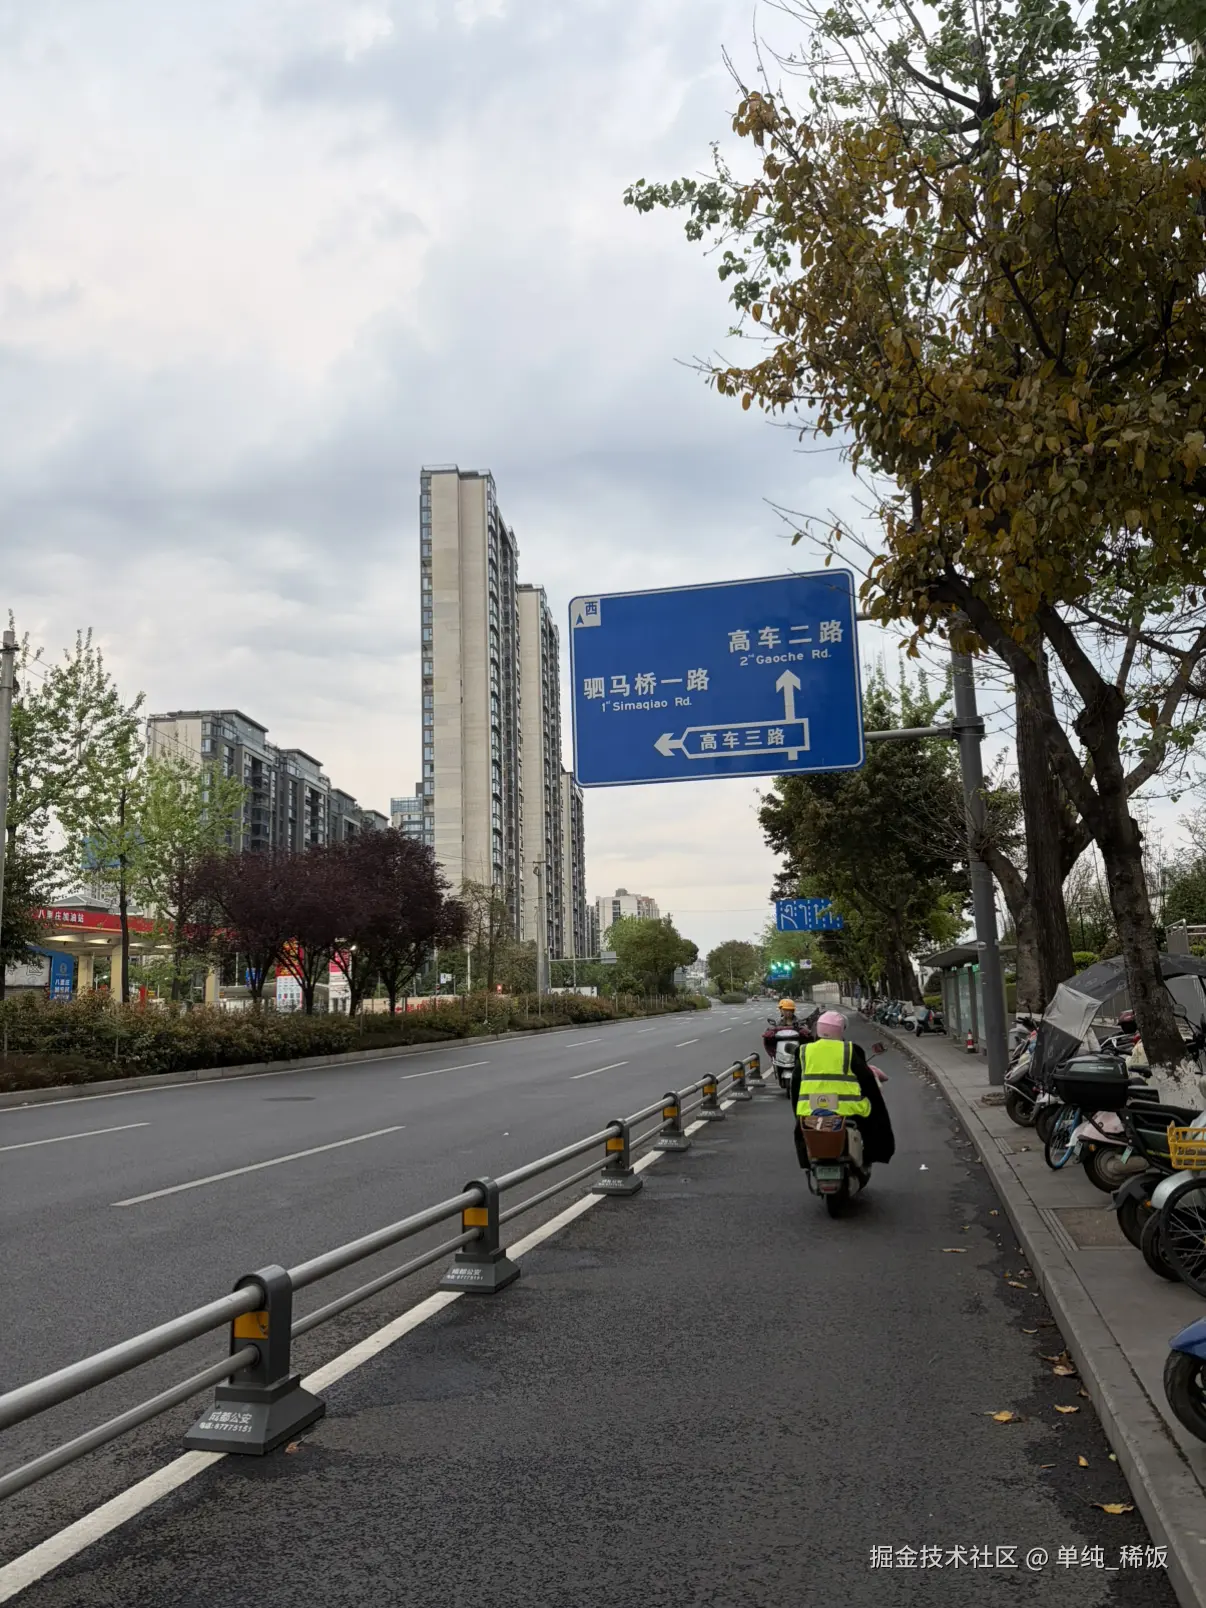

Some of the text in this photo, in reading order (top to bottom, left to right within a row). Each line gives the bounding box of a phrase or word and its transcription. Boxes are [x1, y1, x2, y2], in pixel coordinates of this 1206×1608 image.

[584, 600, 598, 616] 西
[728, 620, 844, 653] 高车二路
[756, 651, 804, 665] Gaoche
[811, 649, 832, 661] Rd.
[584, 668, 710, 699] 驷马桥一路
[612, 698, 668, 711] Simaqiao
[675, 696, 692, 708] Rd.
[700, 729, 785, 751] 高车三路
[208, 1411, 252, 1424] 成都公安
